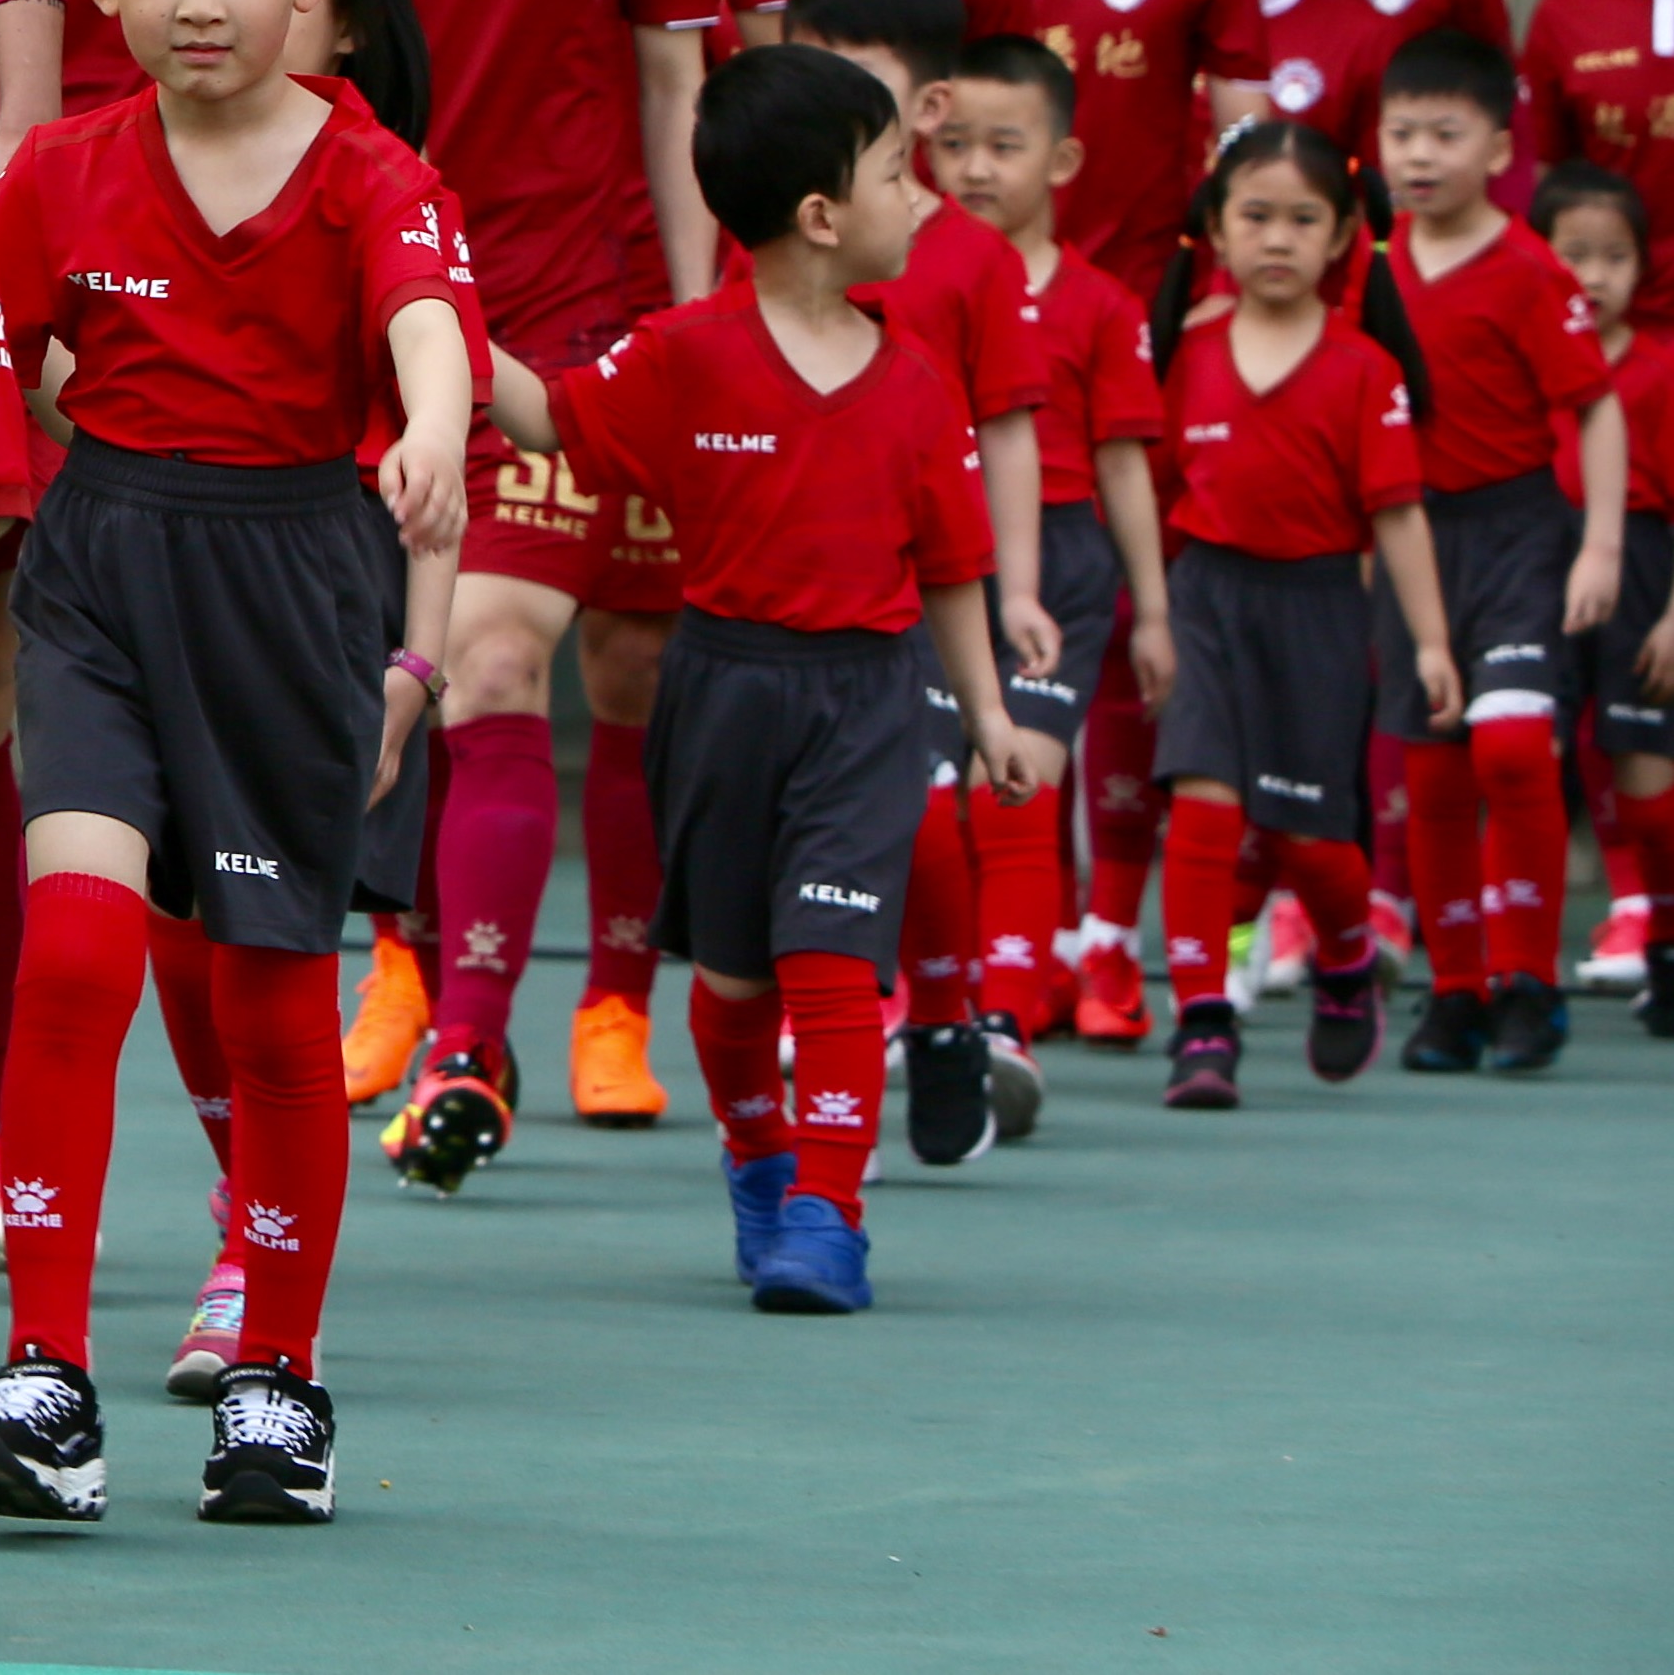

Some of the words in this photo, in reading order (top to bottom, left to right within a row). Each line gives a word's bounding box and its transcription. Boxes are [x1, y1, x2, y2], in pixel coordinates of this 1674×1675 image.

[694, 431, 776, 453] KELME
[495, 502, 589, 540] KELME
[799, 882, 880, 913] KELME
[3, 1213, 64, 1228] KELME
[243, 1226, 301, 1252] KELME
